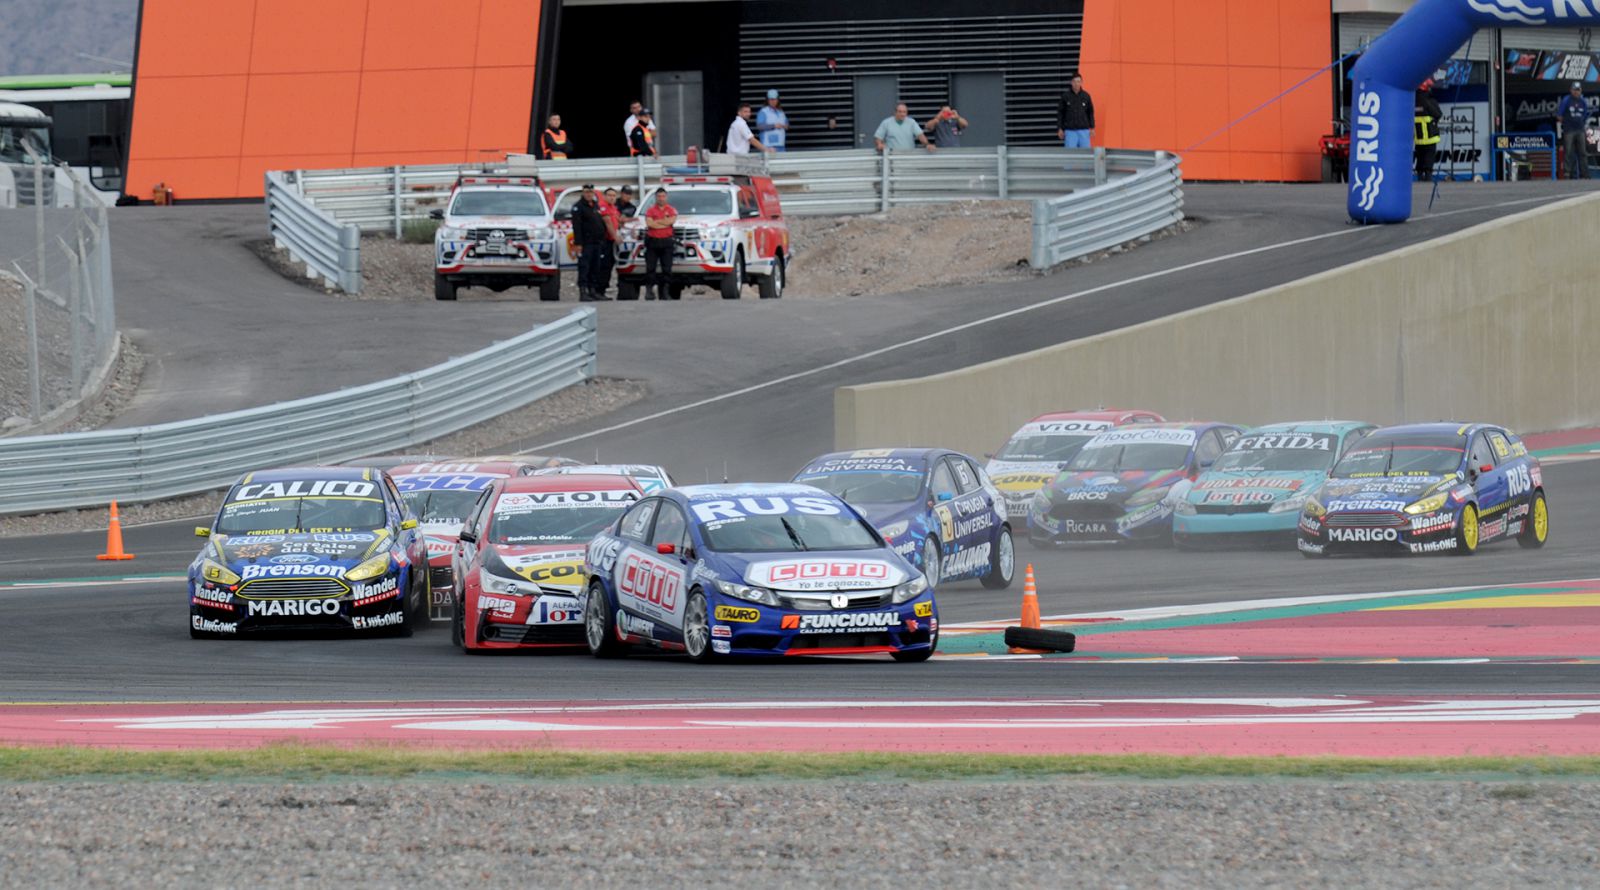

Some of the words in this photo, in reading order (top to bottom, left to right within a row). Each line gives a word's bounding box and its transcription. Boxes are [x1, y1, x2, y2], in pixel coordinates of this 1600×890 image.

[1357, 91, 1381, 162] RUS
[1232, 437, 1330, 450] FRIDA
[806, 464, 918, 474] UNIVERSAL
[825, 458, 906, 466] CIRUGIA
[1506, 464, 1531, 497] RUS
[235, 480, 375, 501] CALICO
[1067, 491, 1109, 501] BROS
[691, 497, 841, 522] RUS
[1327, 500, 1406, 513] Brenson
[953, 512, 993, 539] UNIVERSAL
[1411, 512, 1453, 529] Wander
[1328, 528, 1398, 542] MARIGO
[210, 568, 220, 577] 5
[242, 565, 347, 581] Brenson
[770, 562, 887, 582] COTO
[352, 577, 397, 600] Wander
[620, 554, 681, 613] COTO
[194, 583, 234, 603] Wander
[248, 599, 340, 616] MARIGO
[800, 612, 902, 629] FUNCIONAL
